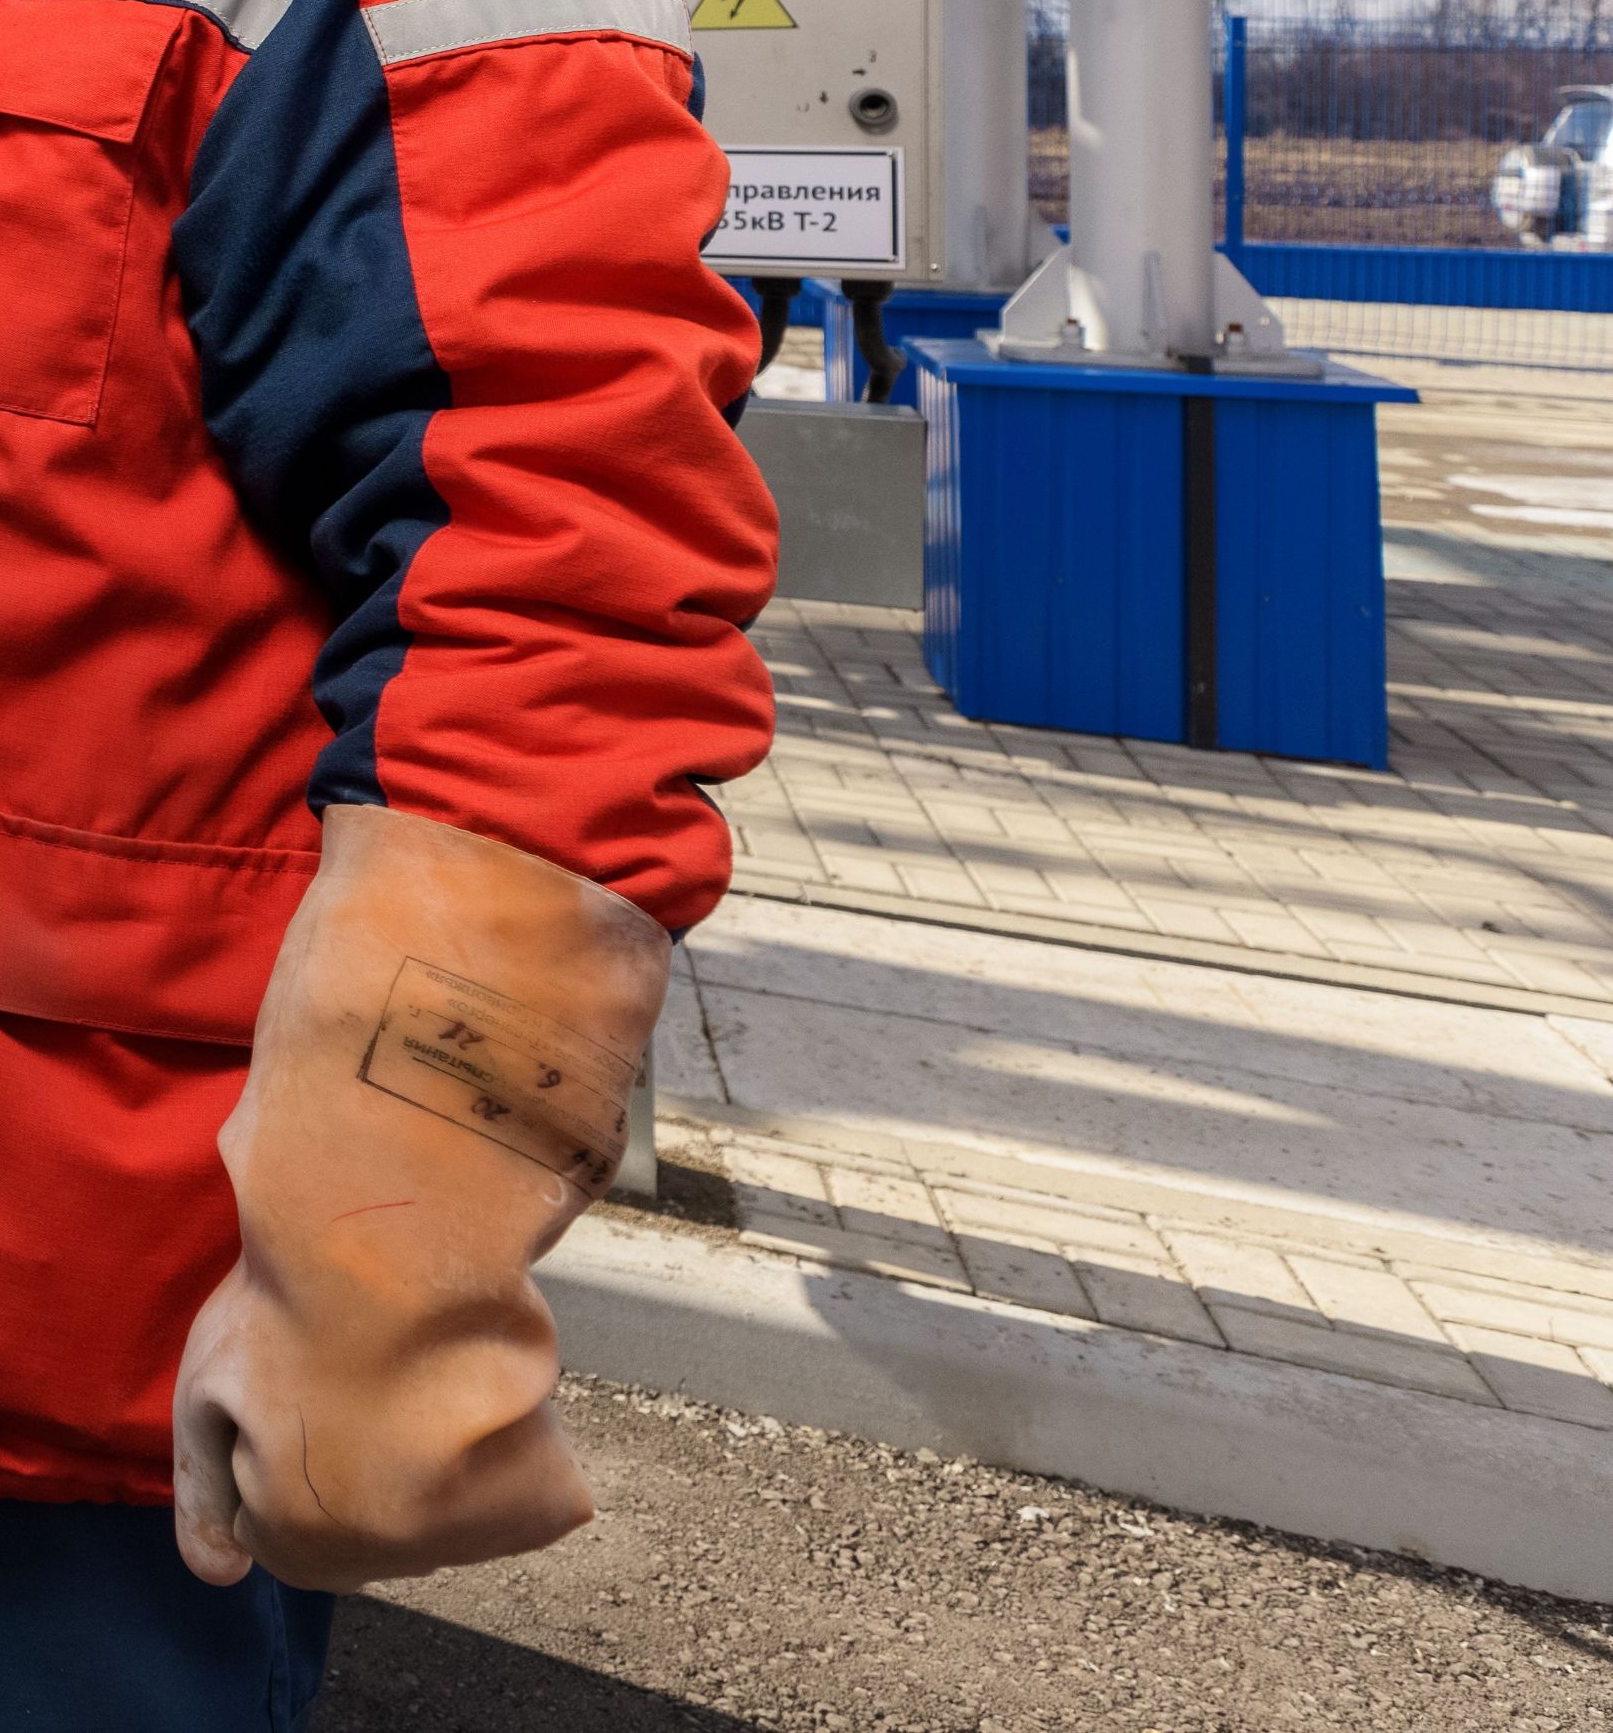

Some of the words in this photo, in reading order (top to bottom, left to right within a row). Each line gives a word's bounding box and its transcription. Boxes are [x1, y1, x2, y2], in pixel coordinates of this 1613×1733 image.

[728, 184, 881, 204] правления
[793, 211, 838, 233] Т-2
[402, 1034, 497, 1086] спытания
